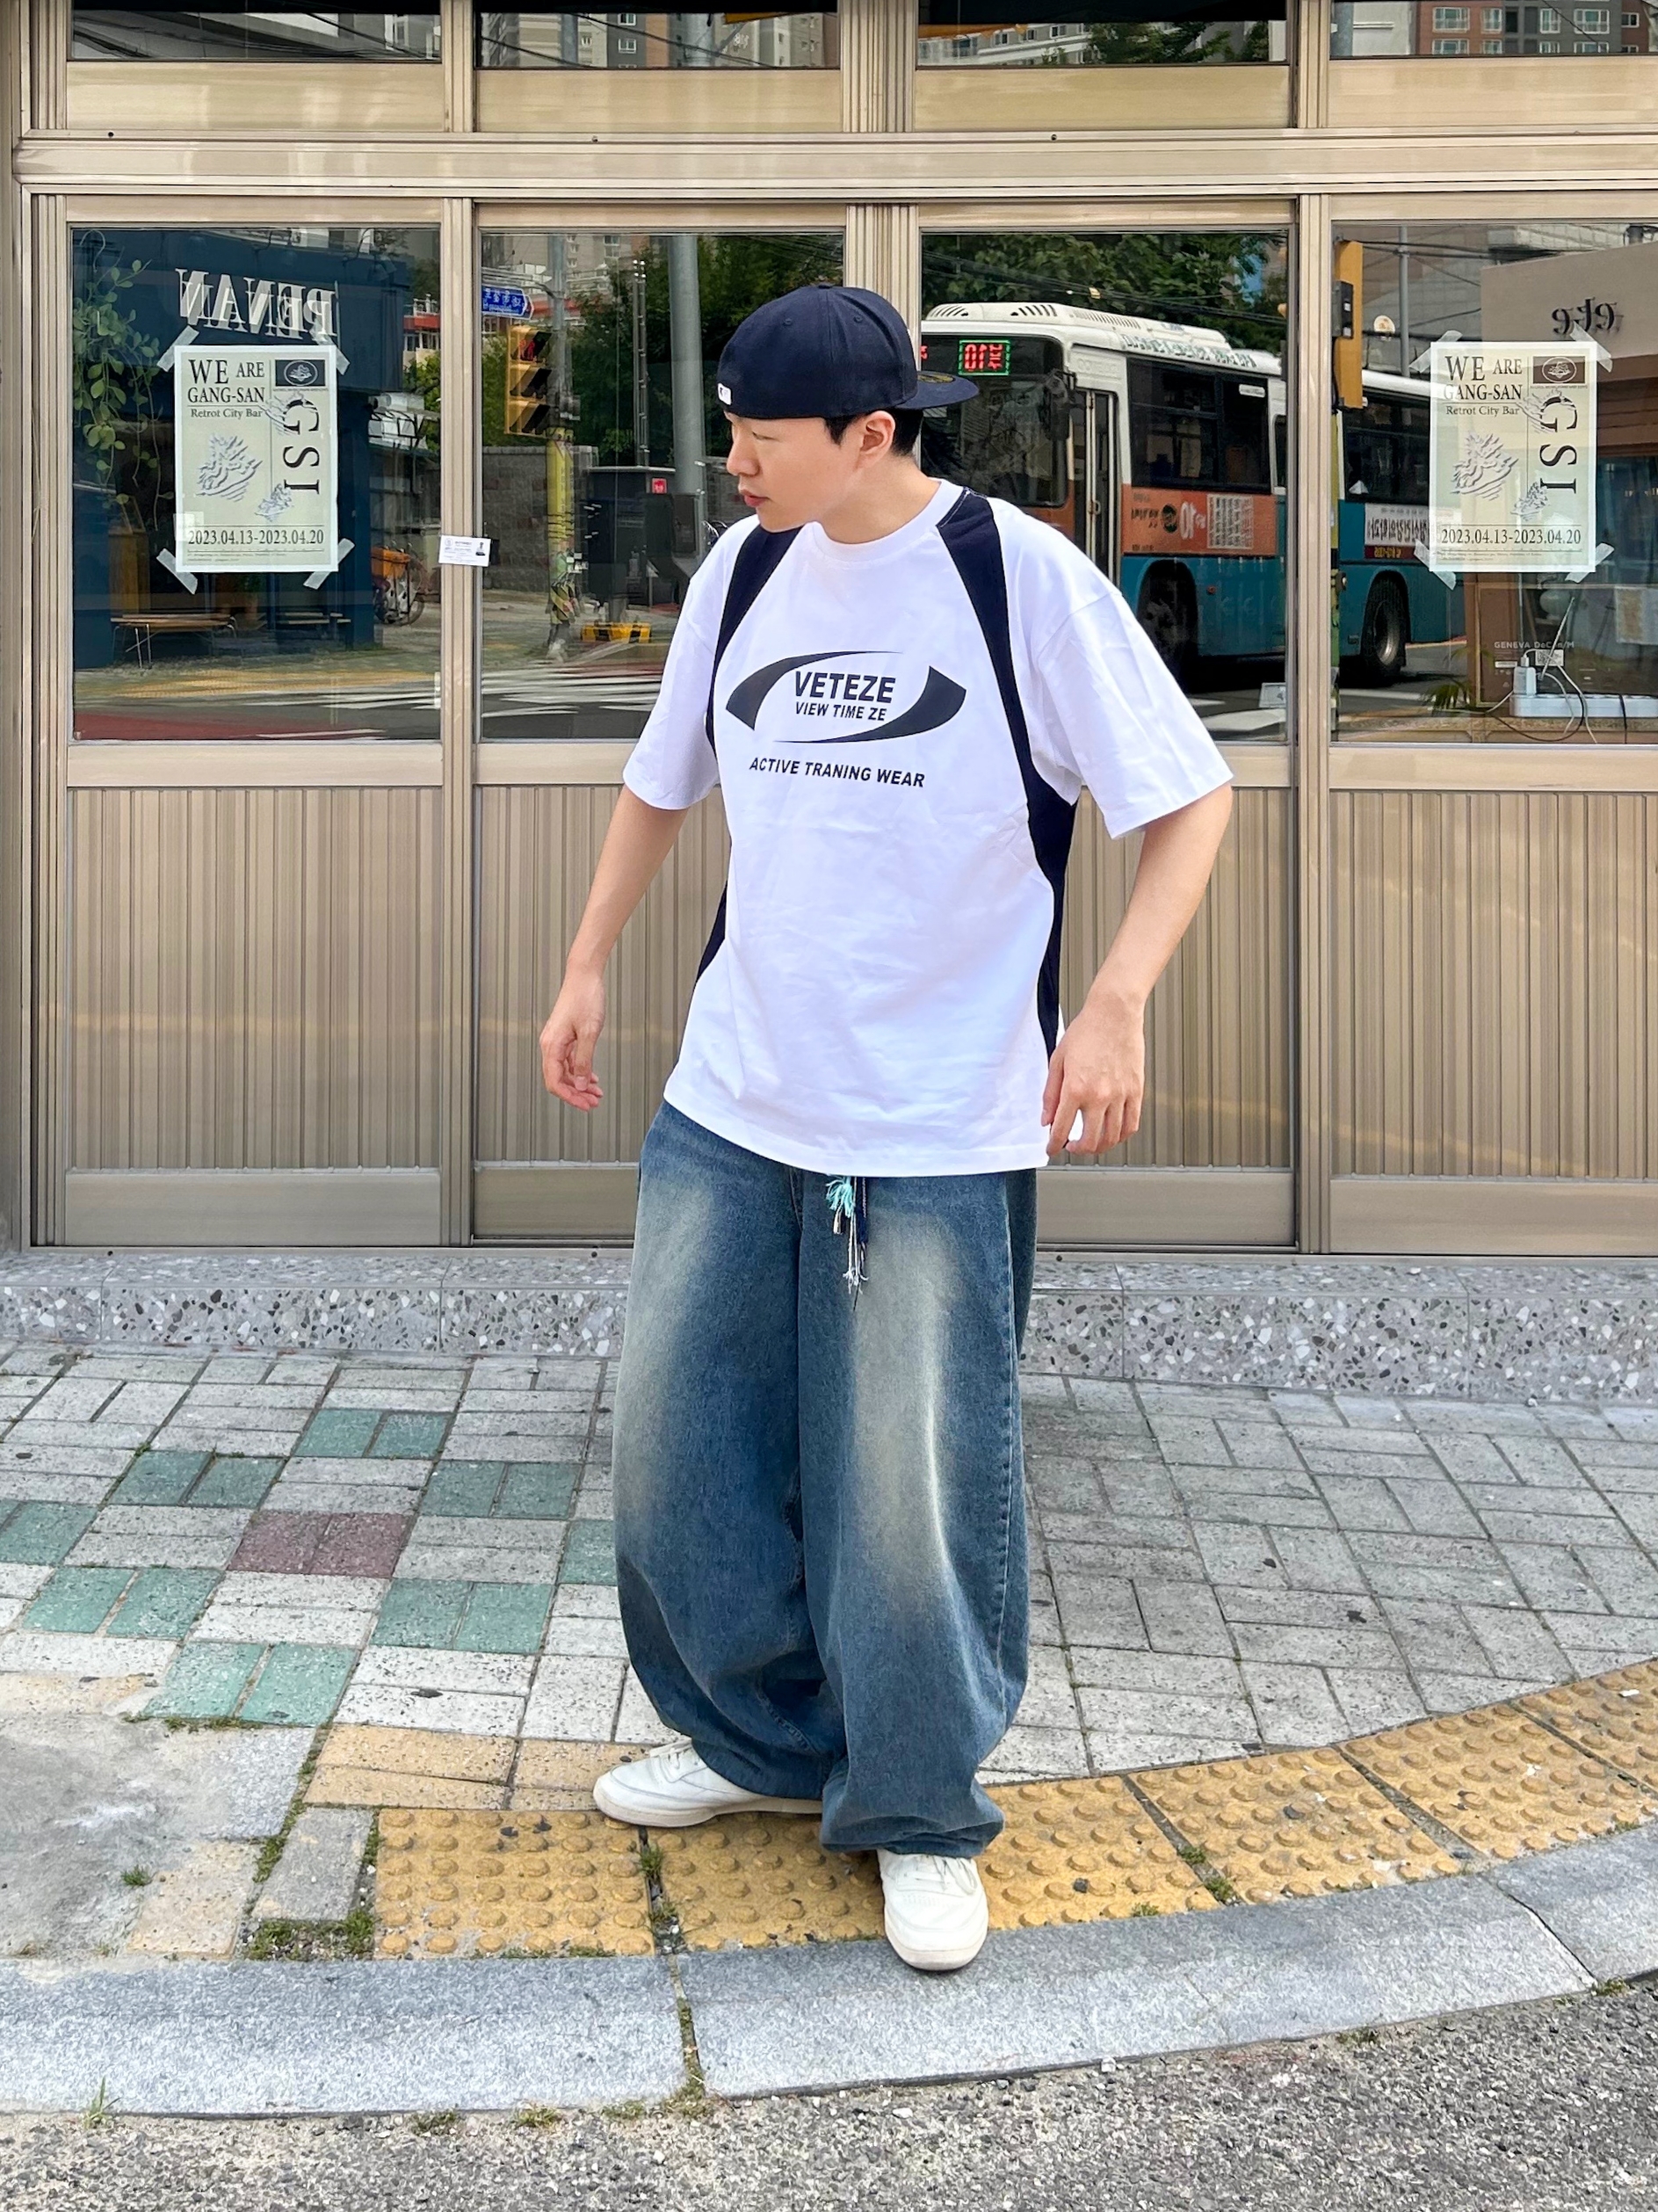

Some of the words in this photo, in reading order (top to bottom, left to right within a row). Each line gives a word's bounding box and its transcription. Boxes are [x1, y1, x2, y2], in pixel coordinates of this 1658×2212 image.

[187, 359, 229, 384] WE
[235, 361, 265, 378] ARE
[1444, 356, 1486, 381] WE
[1492, 359, 1523, 375] ARE
[186, 387, 265, 404] GANG-SAN
[1444, 383, 1524, 402] GANG-SAN
[190, 408, 221, 418] Retrot
[222, 408, 243, 420] City
[245, 408, 264, 418] Bar
[1445, 405, 1476, 416] Retrot
[1478, 405, 1500, 417] City
[1502, 405, 1520, 416] Bar
[187, 529, 324, 545] 2023.04.13-2023.04.20
[1440, 528, 1582, 545] 2023.04.13-2023.04.20
[1494, 641, 1531, 649] GENEVA
[794, 671, 896, 704] VETEZE
[795, 701, 829, 717] VIEW
[832, 704, 864, 720] TIME
[867, 707, 887, 722] ZE
[749, 757, 800, 775] ACTIVE
[805, 761, 872, 781] TRANING
[876, 768, 925, 788] WEAR
